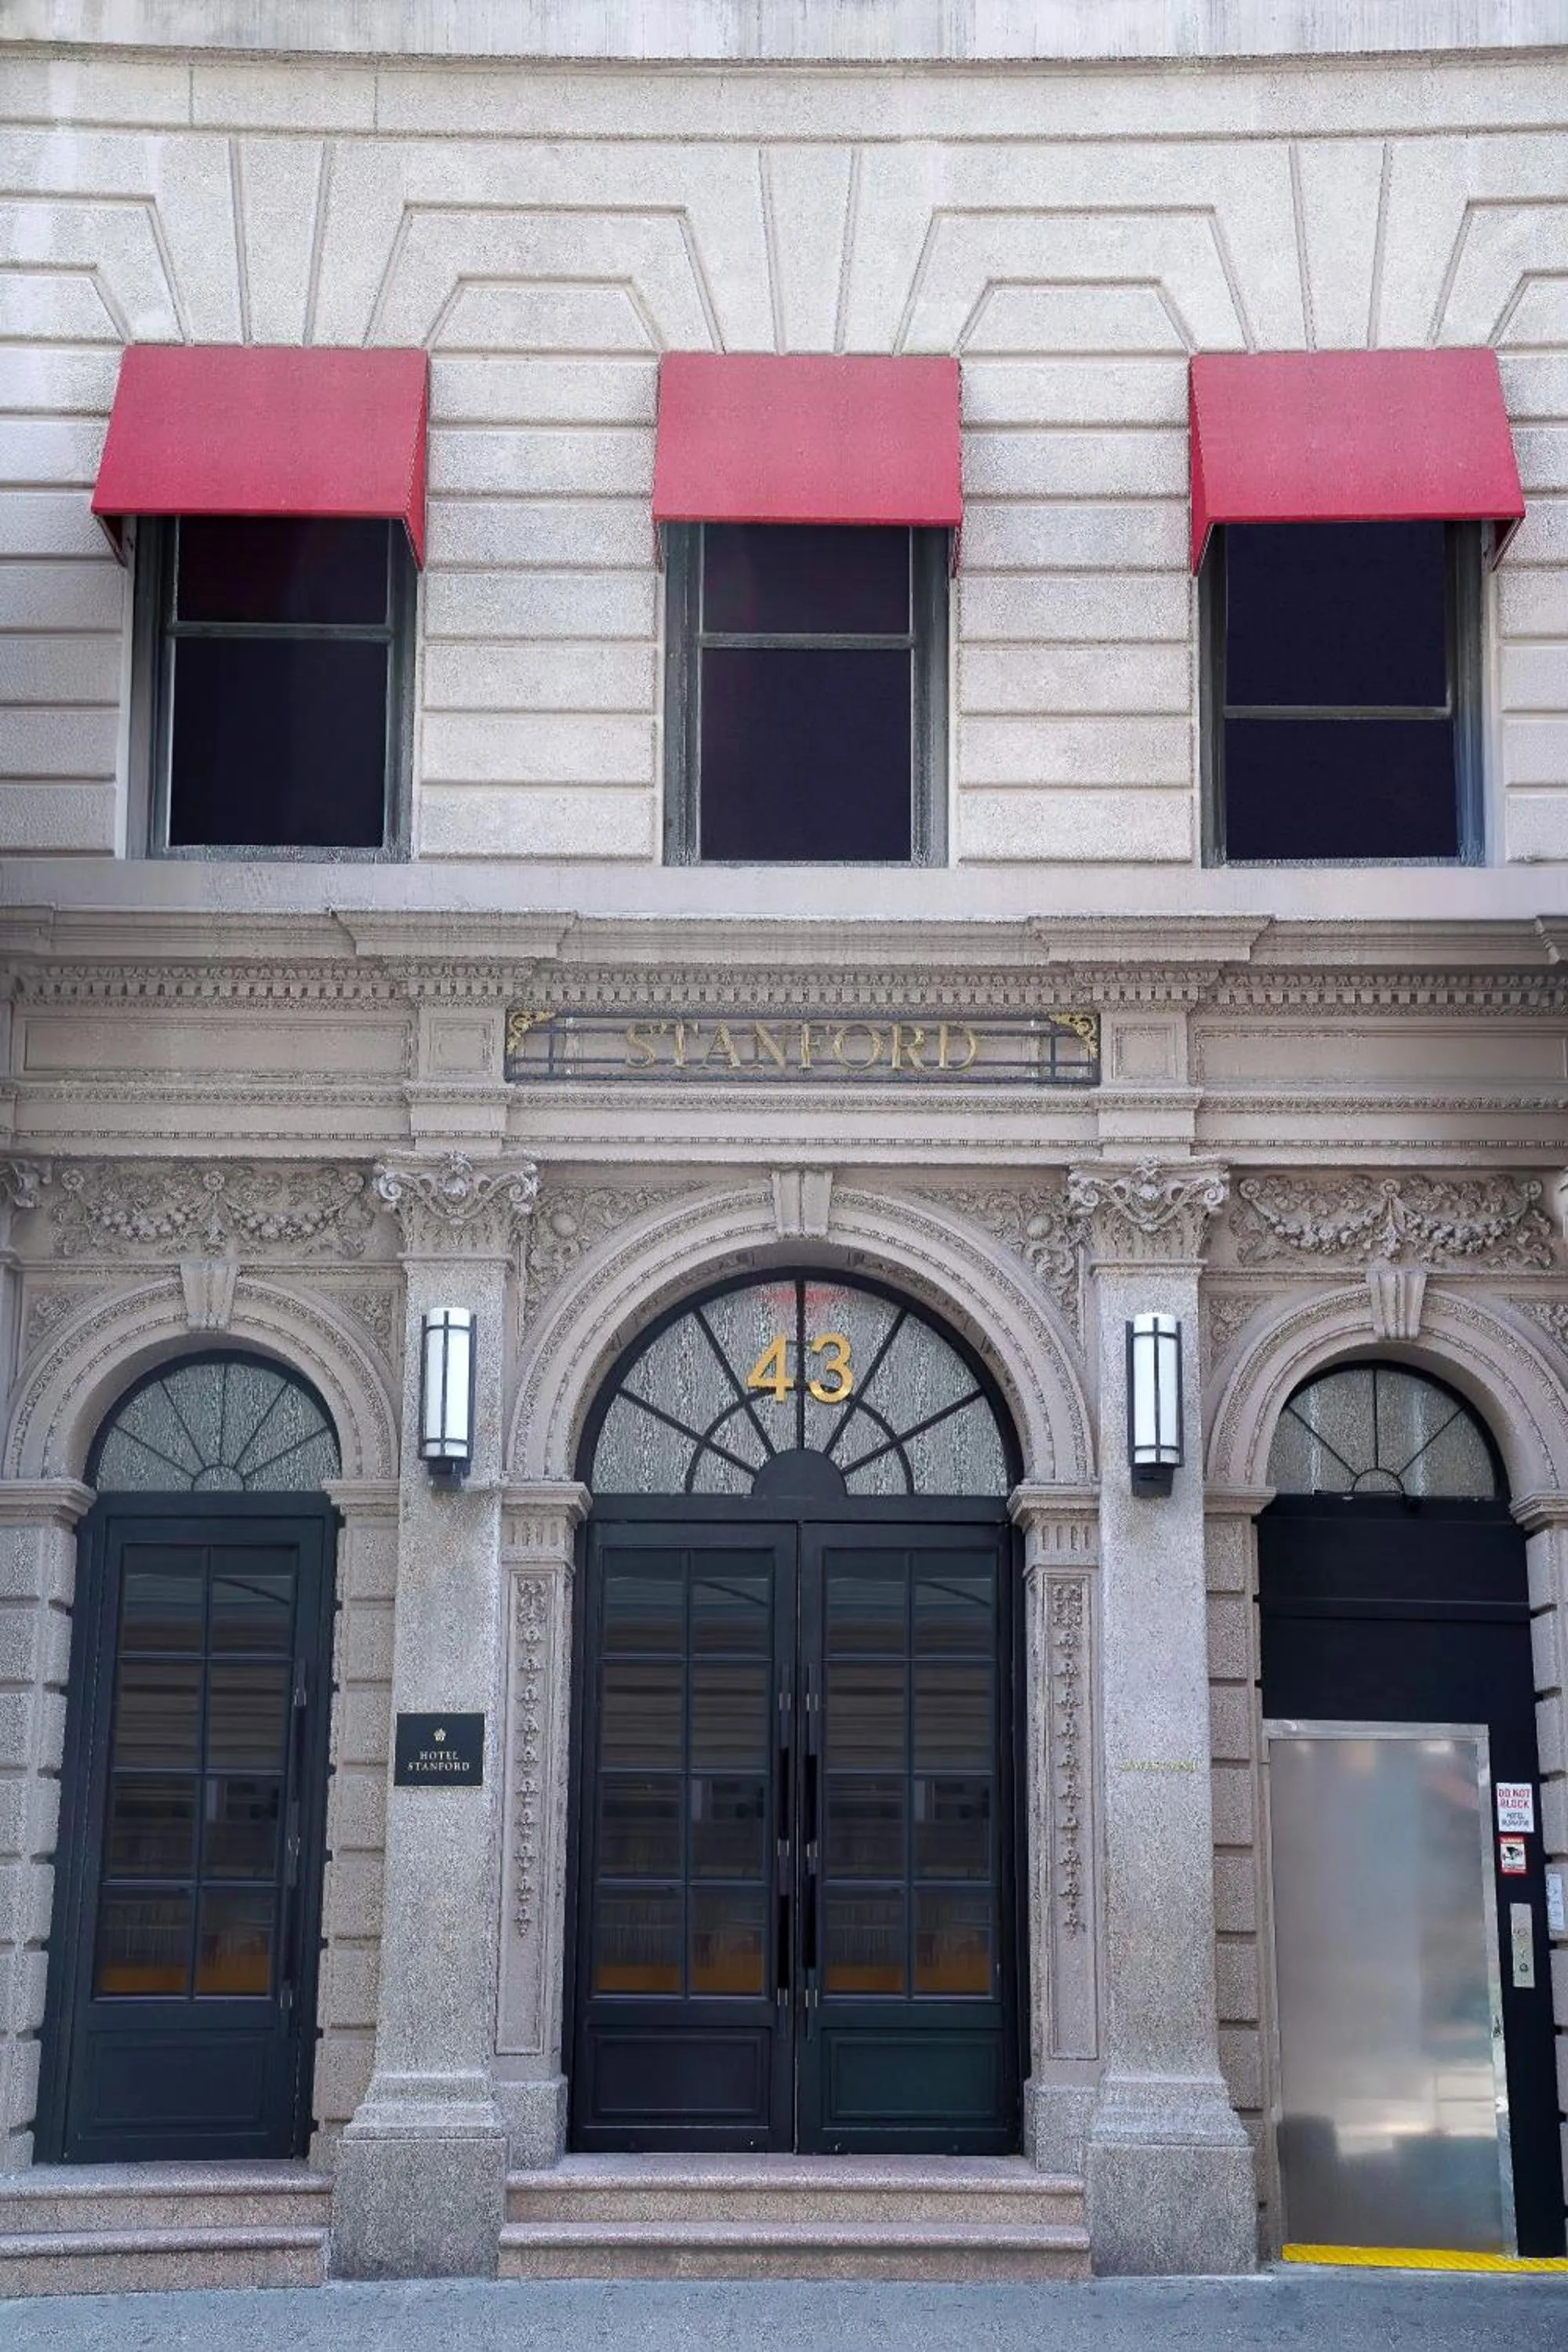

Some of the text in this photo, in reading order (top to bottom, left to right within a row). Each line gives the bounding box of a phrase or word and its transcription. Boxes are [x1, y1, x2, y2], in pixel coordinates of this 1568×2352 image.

[626, 1022, 978, 1071] STANFORD
[747, 1333, 853, 1403] 43
[419, 1751, 458, 1760] HOTEL
[408, 1762, 470, 1771] STANFORD
[1498, 1788, 1530, 1798] DO NOT
[1499, 1798, 1530, 1808] BLOCK
